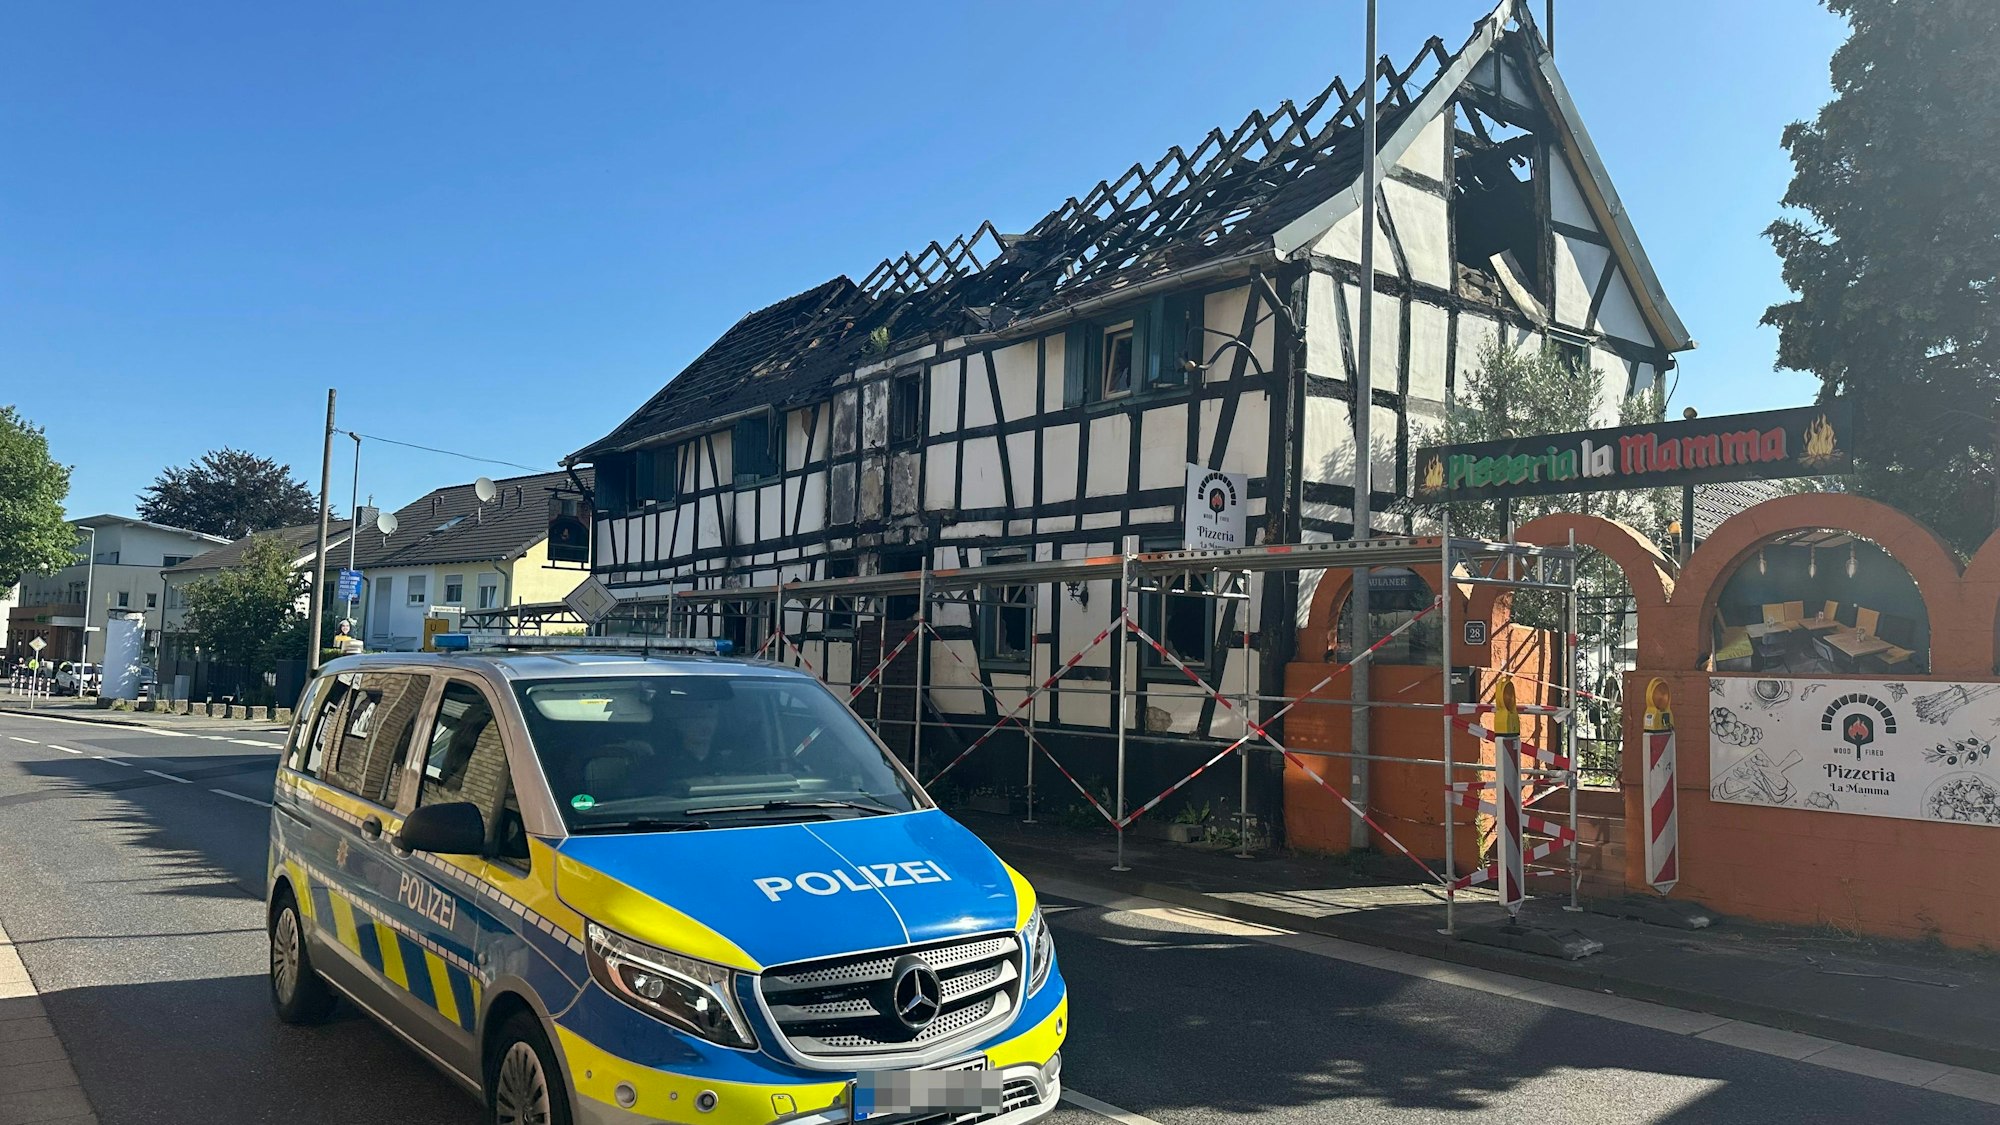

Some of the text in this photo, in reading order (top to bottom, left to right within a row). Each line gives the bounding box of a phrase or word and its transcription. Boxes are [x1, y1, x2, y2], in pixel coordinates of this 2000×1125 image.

[1448, 426, 1789, 490] Pizzeria la Mamma
[1197, 525, 1234, 542] Pizzeria
[430, 623, 437, 632] U
[1469, 628, 1481, 638] 28
[1833, 747, 1851, 755] WOOD
[1822, 763, 1896, 782] Pizzeria
[1829, 783, 1890, 796] La Mamma
[752, 860, 953, 902] POLIZEI
[398, 871, 456, 931] POLIZEI
